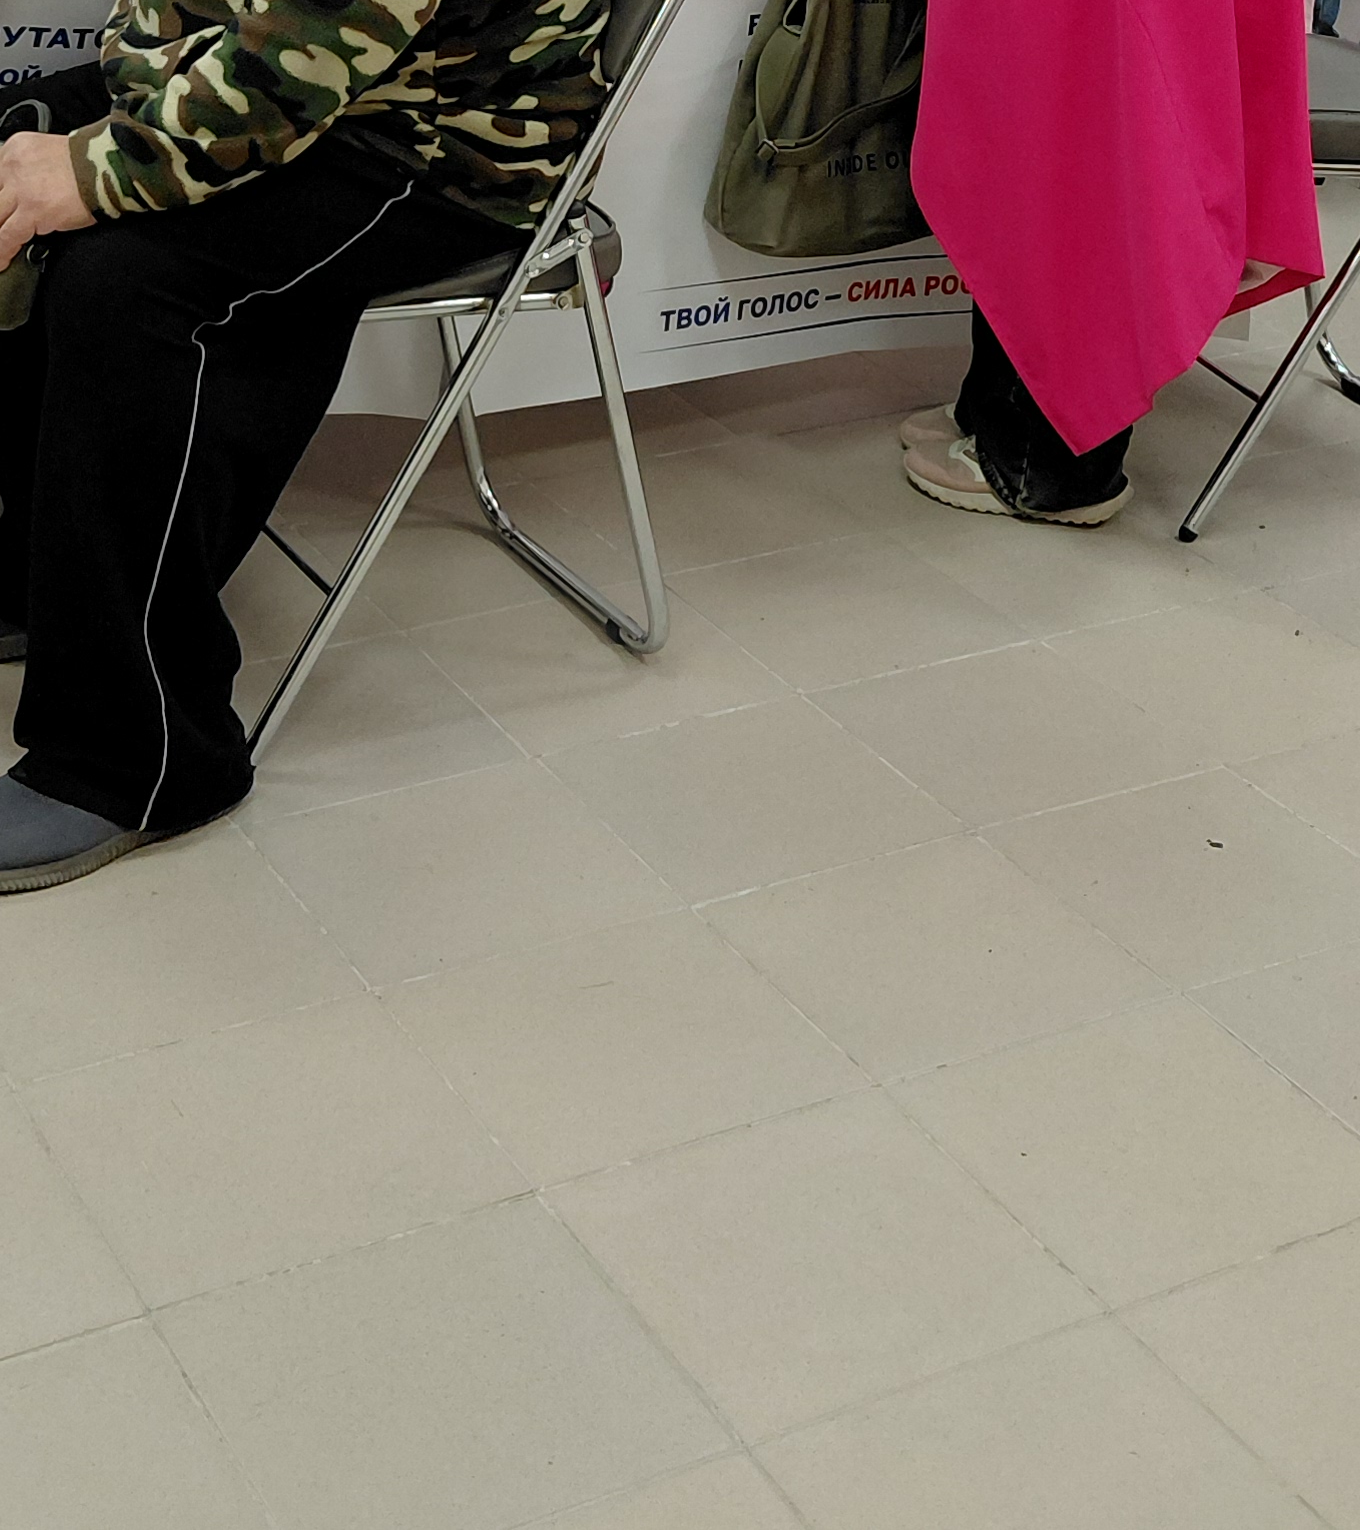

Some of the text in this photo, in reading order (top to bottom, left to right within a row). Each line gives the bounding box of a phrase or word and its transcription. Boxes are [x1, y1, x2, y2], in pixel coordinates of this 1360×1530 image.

[661, 296, 730, 331] ТВОЙ
[738, 289, 819, 320] ГОЛОС
[848, 277, 916, 302] СИЛА
